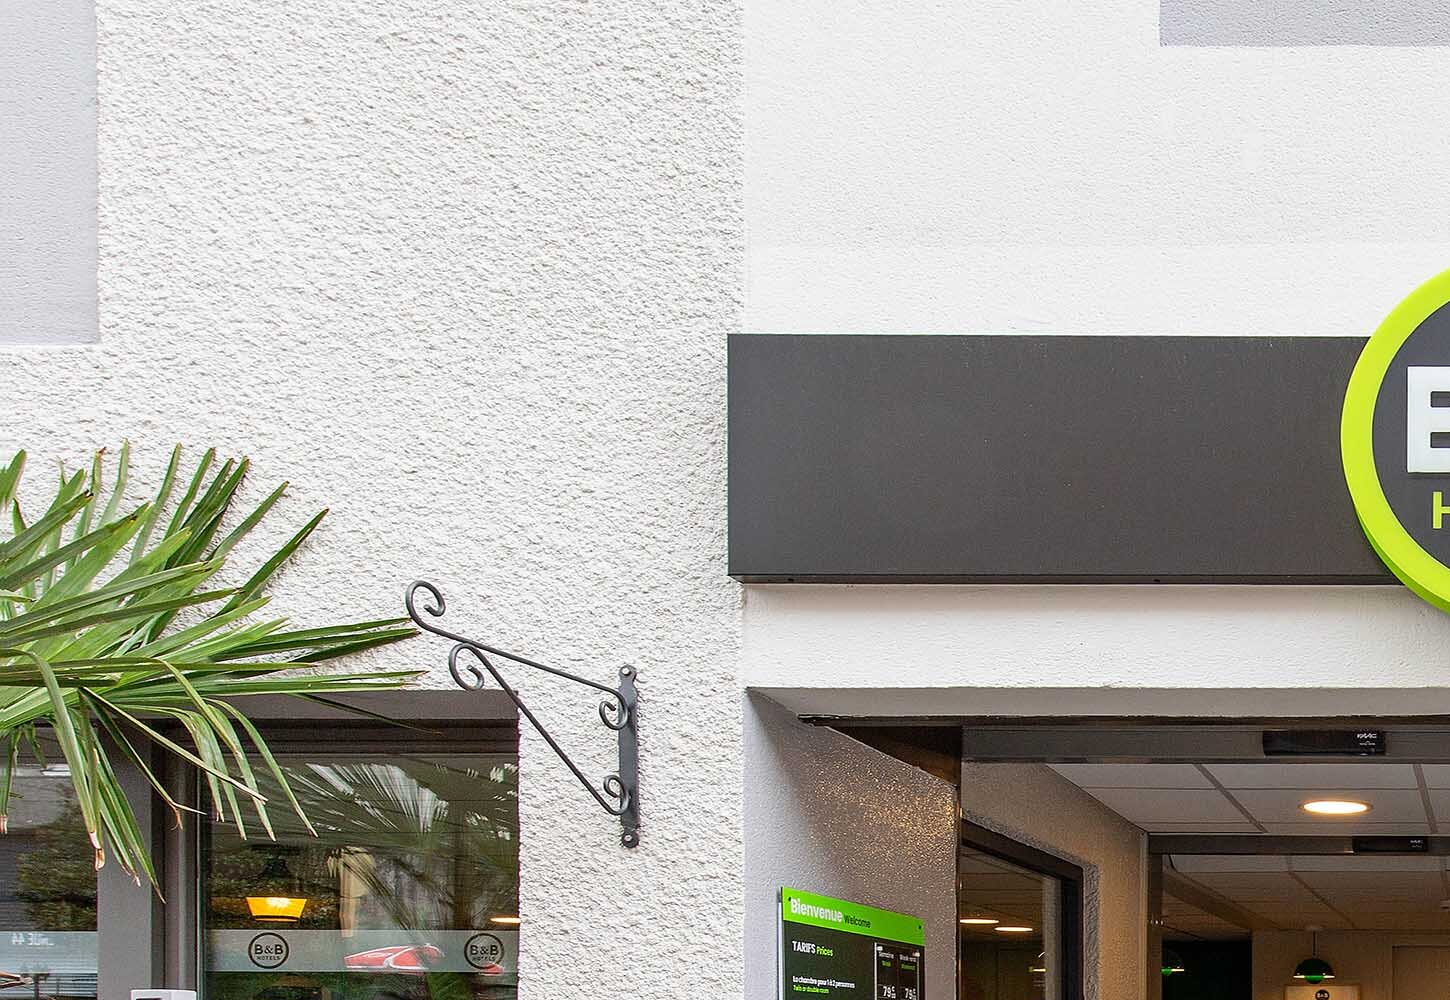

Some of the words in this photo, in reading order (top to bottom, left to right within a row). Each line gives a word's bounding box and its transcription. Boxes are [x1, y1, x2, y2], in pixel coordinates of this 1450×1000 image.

[790, 898, 843, 923] Bienvenue
[844, 915, 872, 929] Welcome
[255, 944, 283, 955] B&B
[470, 945, 499, 955] B&B
[791, 940, 816, 954] TARIFS
[816, 946, 833, 957] Prices
